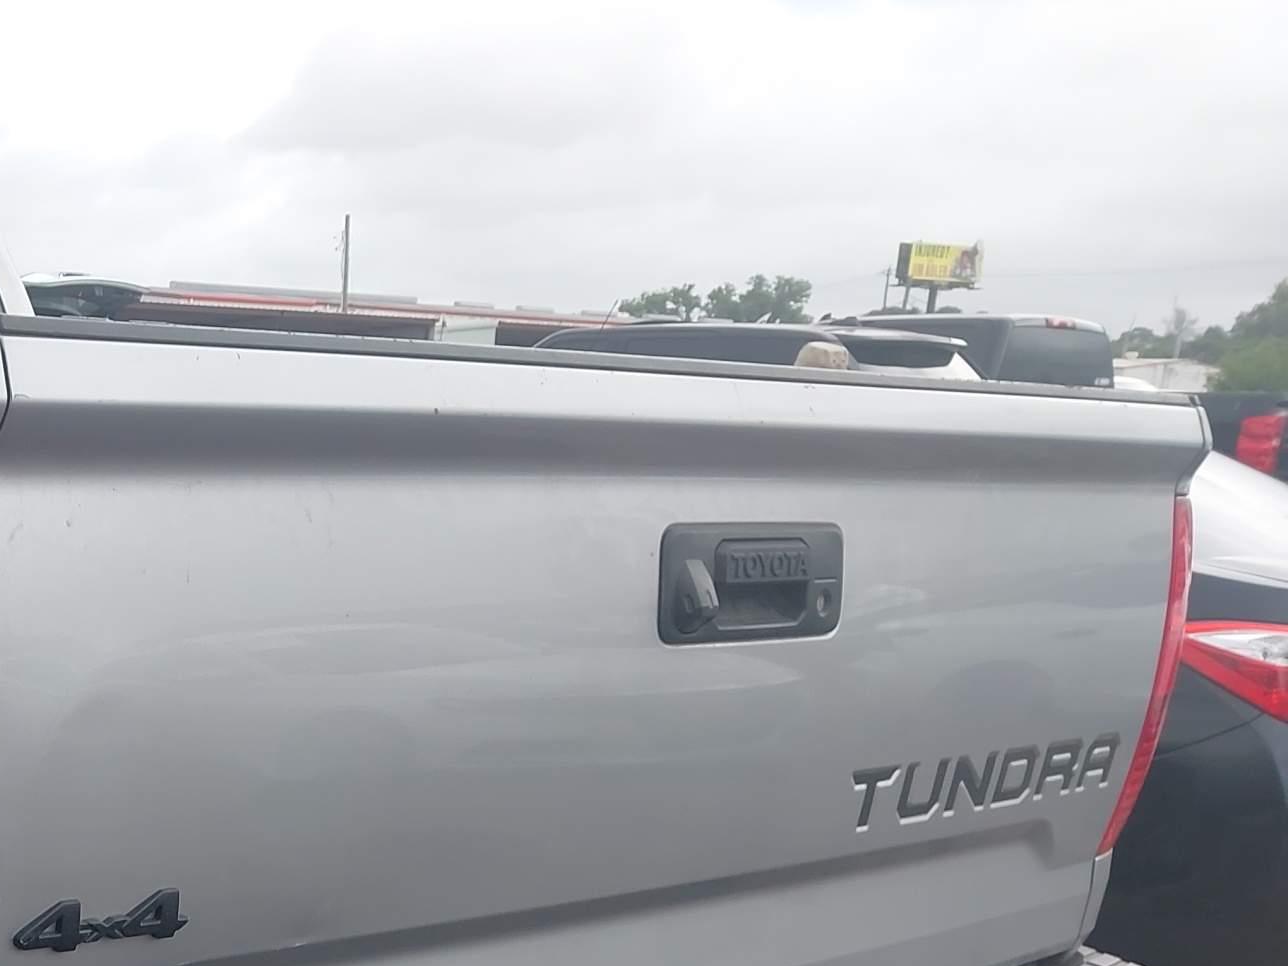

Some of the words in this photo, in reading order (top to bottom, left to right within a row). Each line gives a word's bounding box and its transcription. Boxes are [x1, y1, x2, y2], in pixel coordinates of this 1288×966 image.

[730, 550, 809, 580] TOYOTA
[851, 731, 1121, 833] TUNDRA
[12, 887, 190, 952] 4x4
